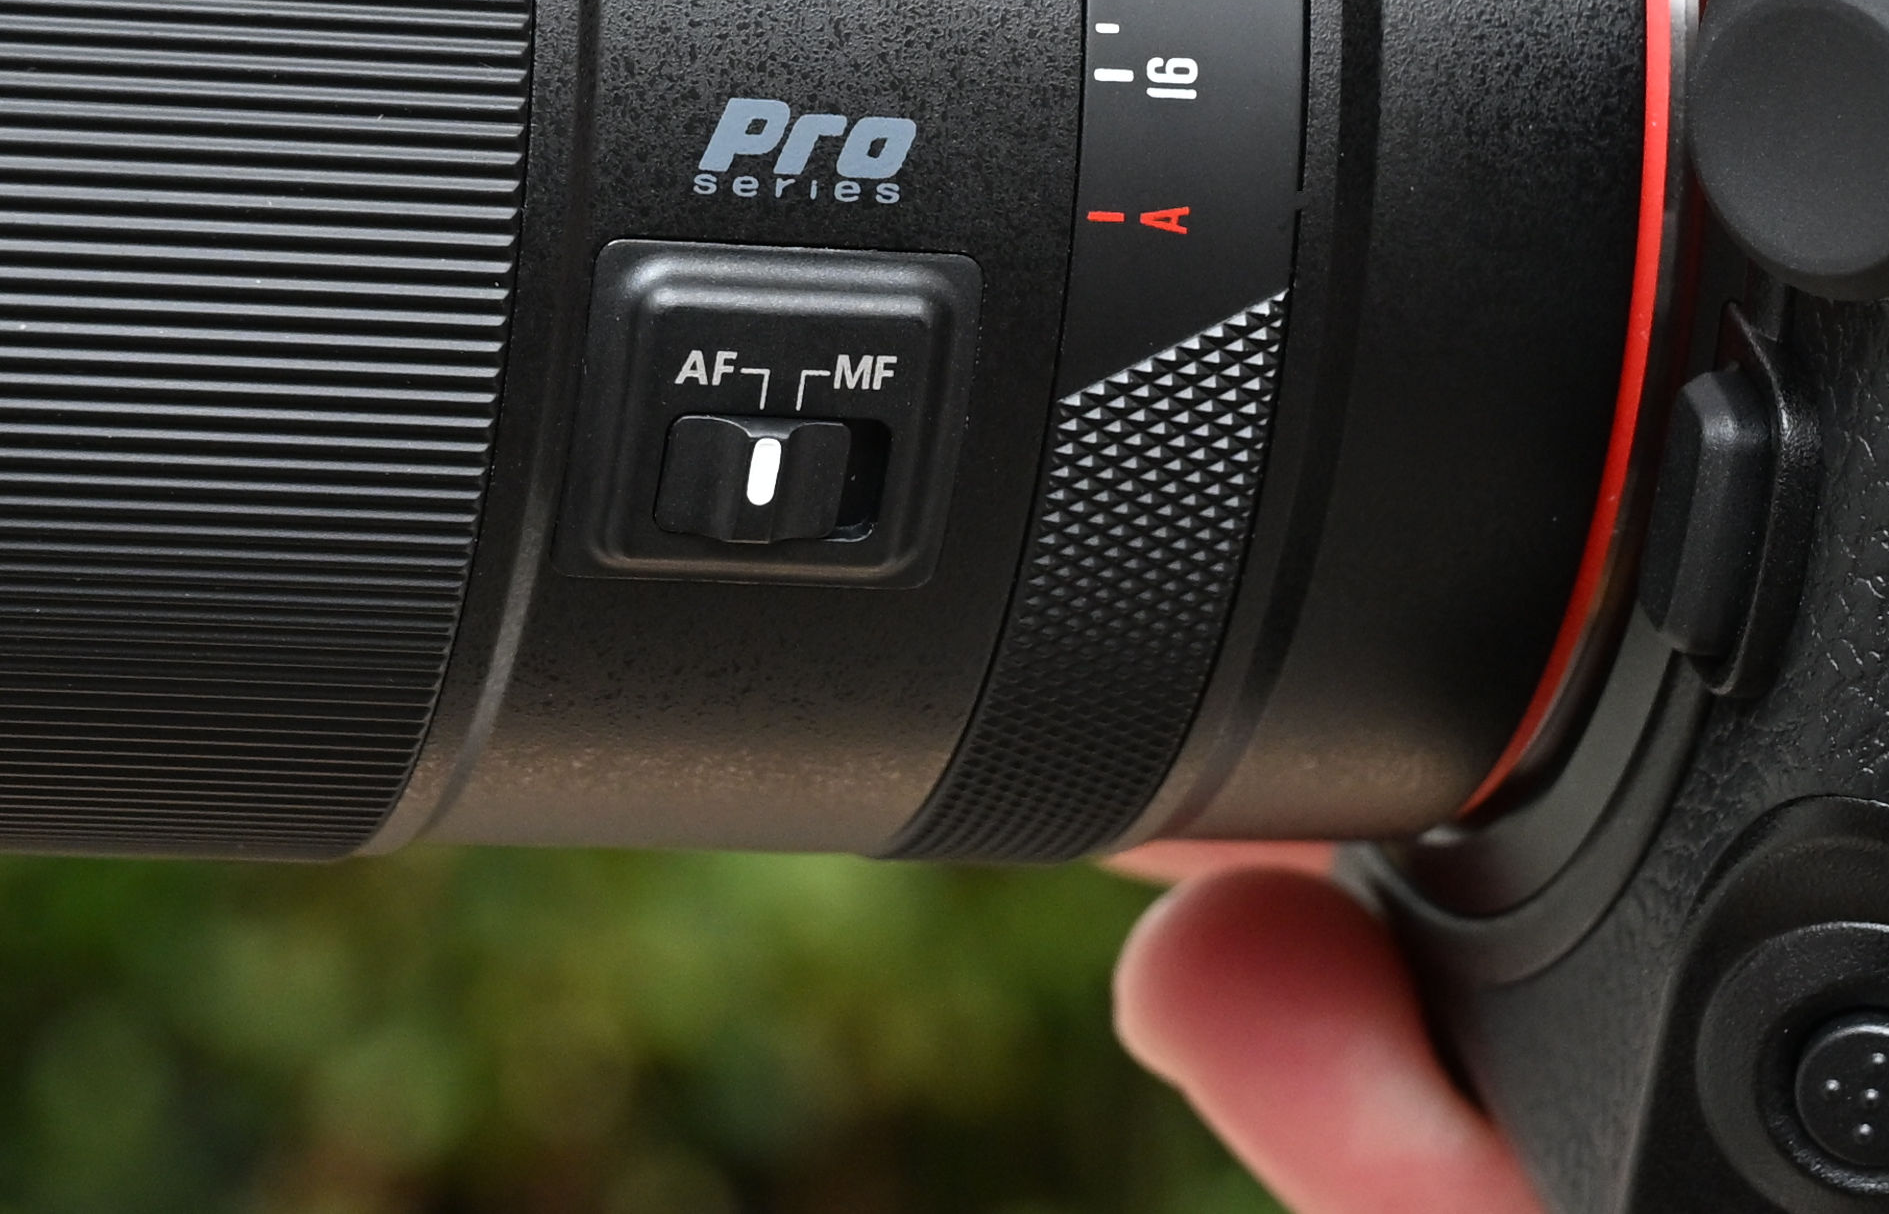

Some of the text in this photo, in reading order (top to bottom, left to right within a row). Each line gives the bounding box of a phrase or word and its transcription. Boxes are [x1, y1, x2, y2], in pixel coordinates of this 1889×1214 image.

[1146, 56, 1198, 100] 16
[697, 97, 917, 180] Pro
[693, 173, 900, 204] series
[1140, 206, 1190, 235] A
[675, 350, 738, 386] AF
[833, 355, 898, 390] MF
